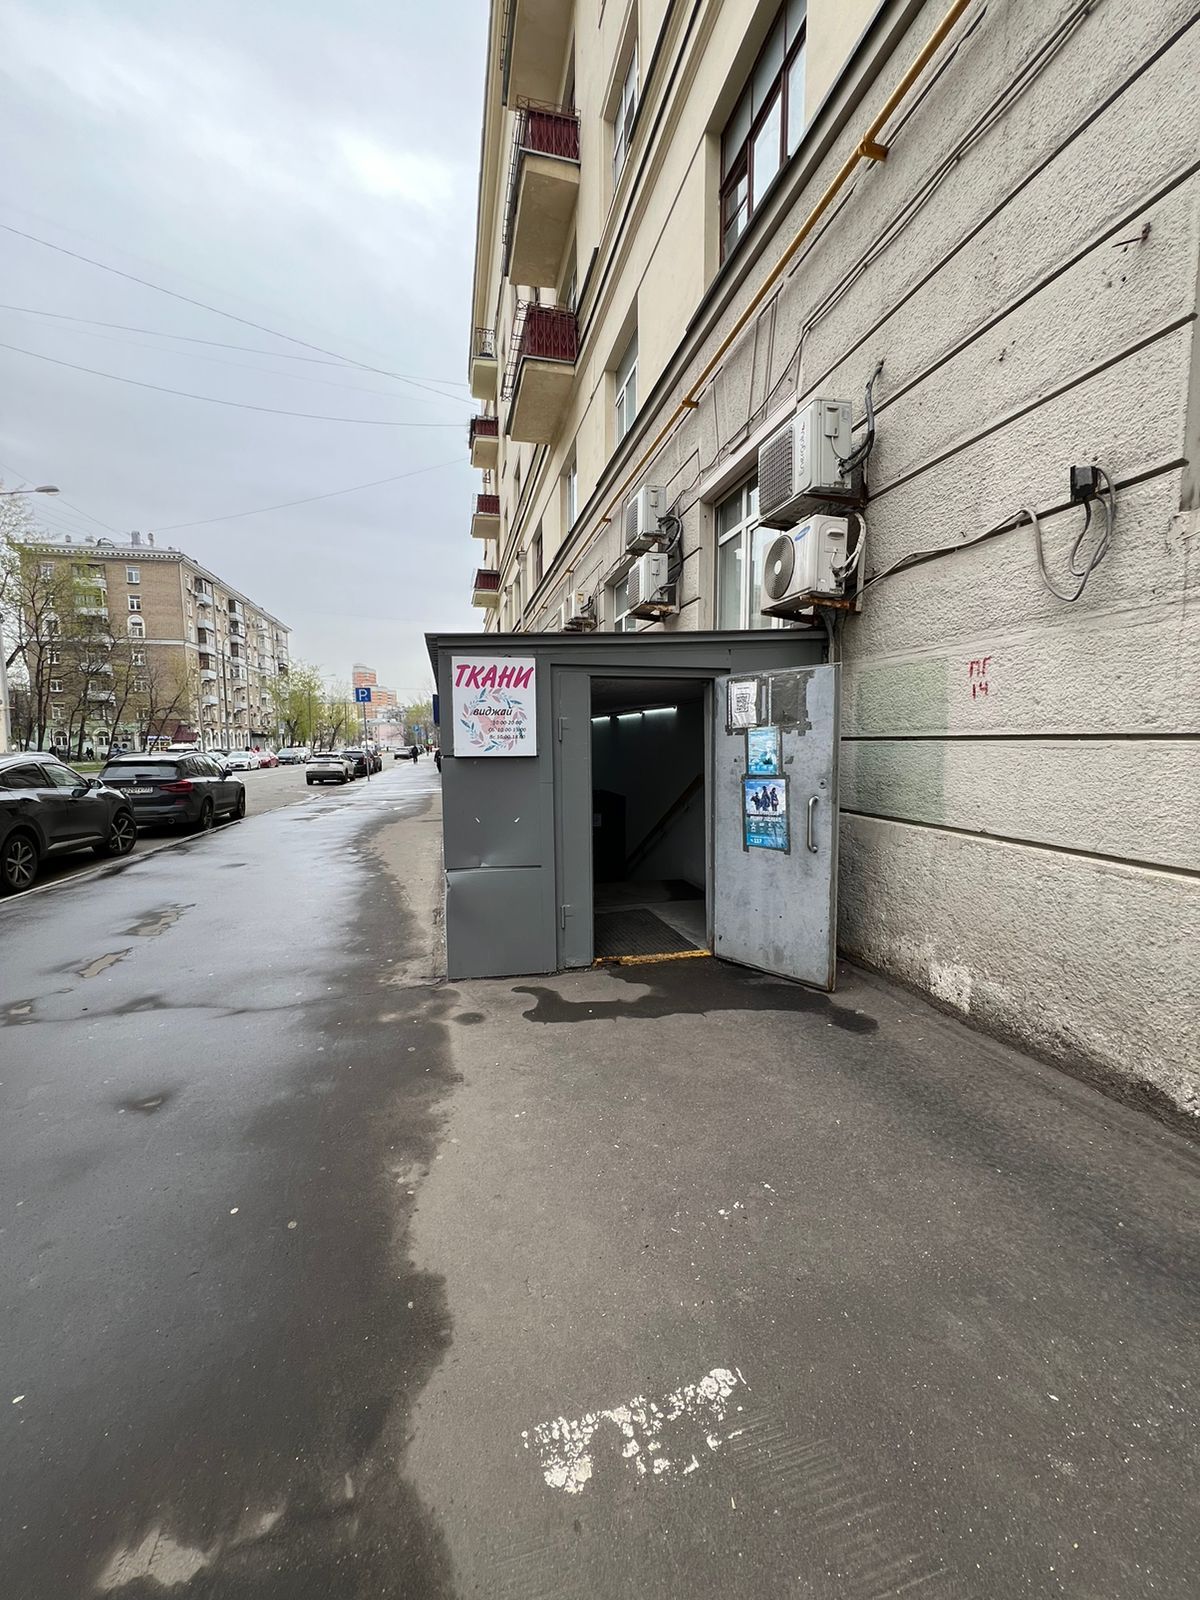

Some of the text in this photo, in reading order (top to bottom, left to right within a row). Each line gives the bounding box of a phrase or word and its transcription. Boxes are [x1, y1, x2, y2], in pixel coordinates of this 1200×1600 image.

[455, 664, 534, 689] ТКАНИ
[358, 689, 368, 701] P
[473, 706, 513, 716] виджай
